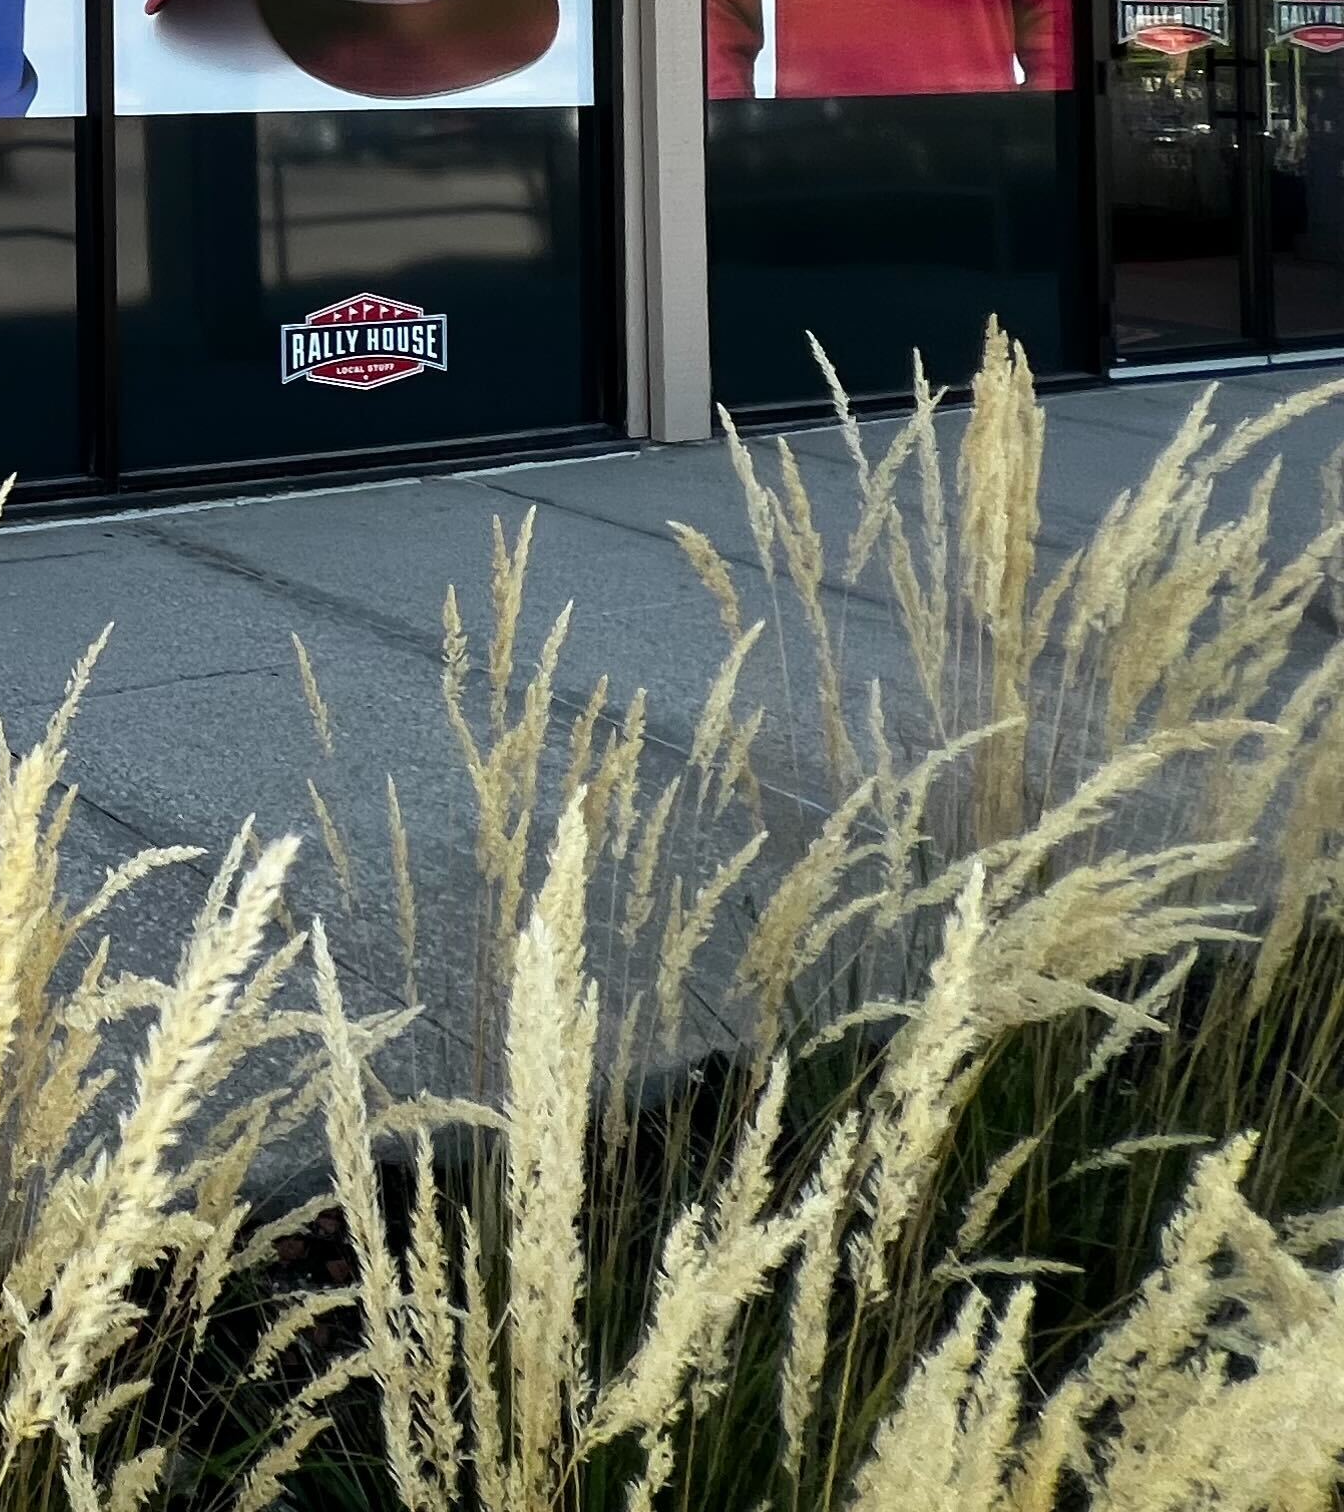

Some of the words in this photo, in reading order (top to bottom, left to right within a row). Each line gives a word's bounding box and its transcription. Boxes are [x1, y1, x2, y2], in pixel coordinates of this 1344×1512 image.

[291, 329, 359, 369] RALLY
[367, 324, 438, 359] HOUSE
[336, 365, 365, 375] LOCAL
